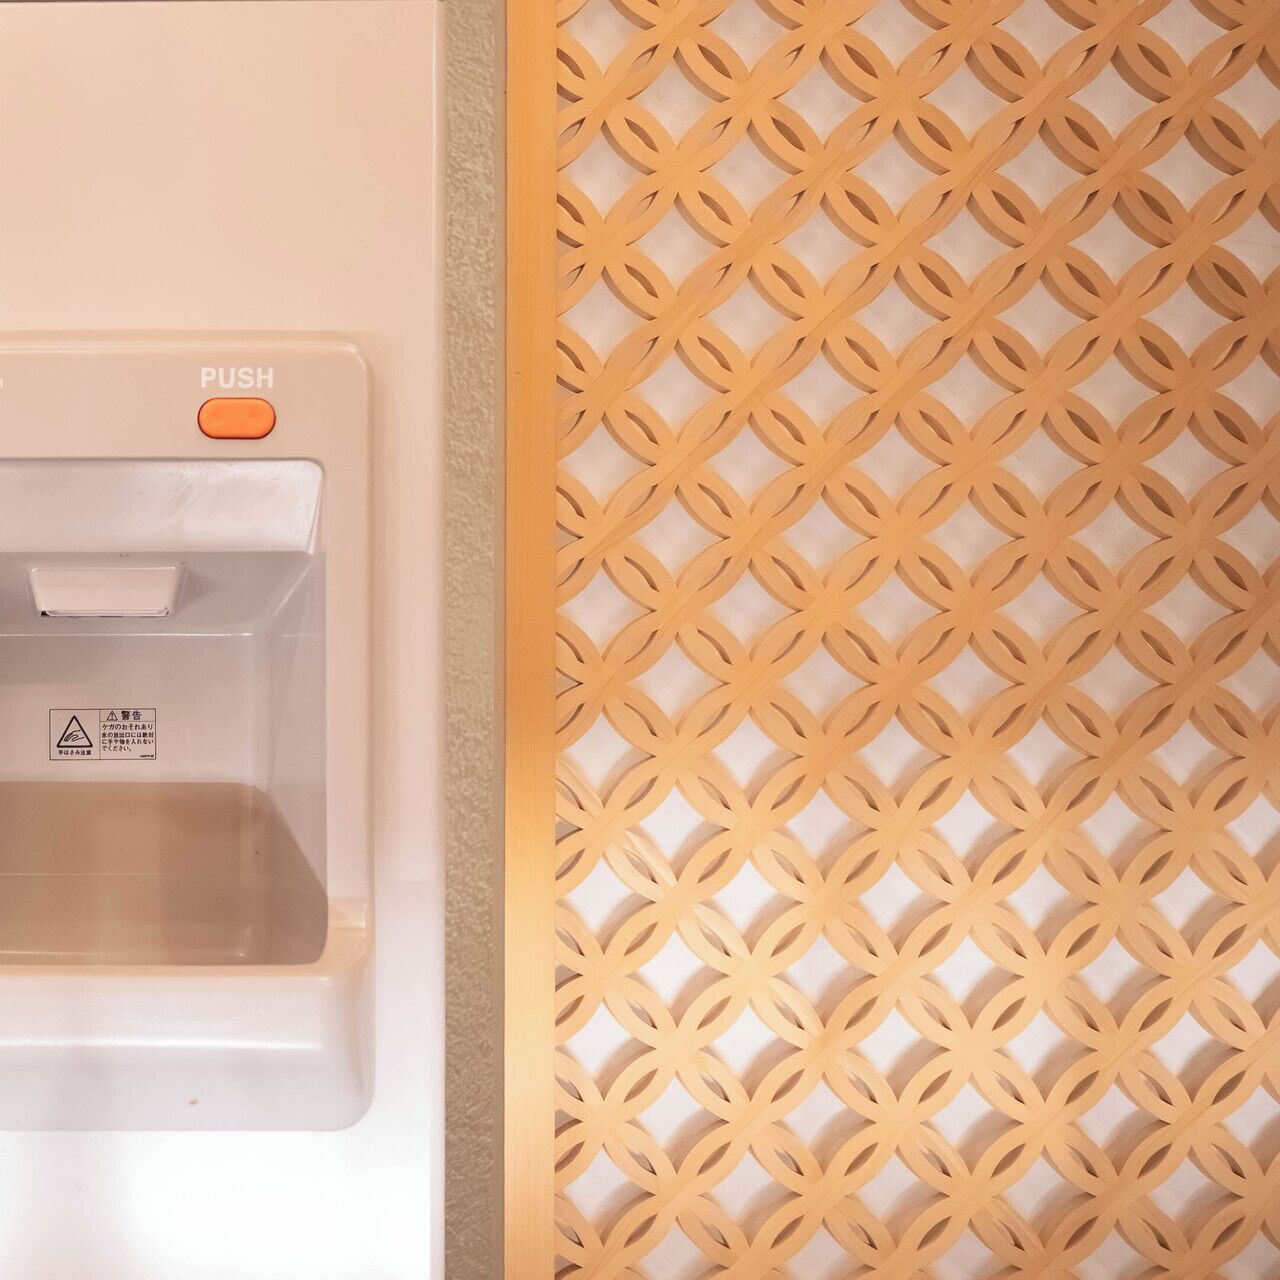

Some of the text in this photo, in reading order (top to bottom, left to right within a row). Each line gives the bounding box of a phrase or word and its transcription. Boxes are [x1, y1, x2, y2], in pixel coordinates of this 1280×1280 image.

[199, 367, 275, 389] PUSH
[120, 710, 141, 721] 警告
[102, 723, 154, 731] ケガのおそれあり
